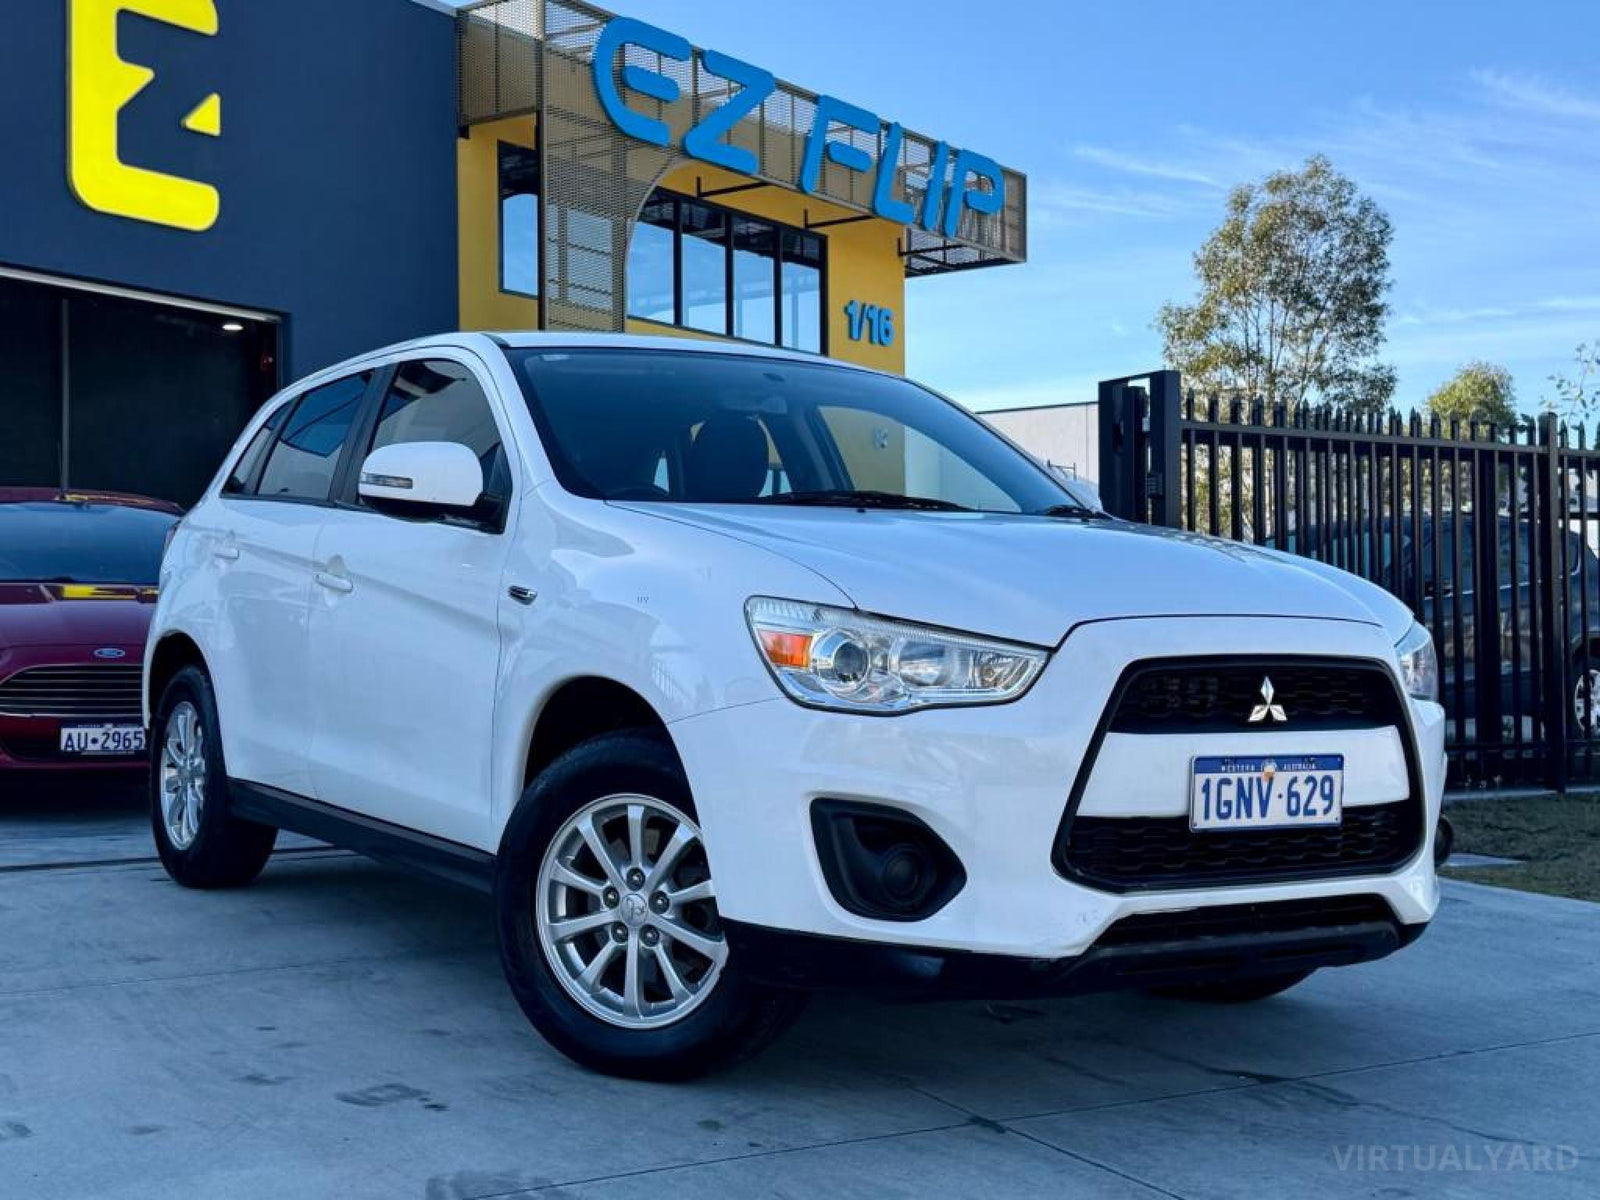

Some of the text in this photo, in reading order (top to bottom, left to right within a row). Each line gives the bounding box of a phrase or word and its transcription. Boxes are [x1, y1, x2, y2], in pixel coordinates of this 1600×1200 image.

[593, 17, 1005, 238] EZ FLIP
[844, 300, 895, 346] 1/16
